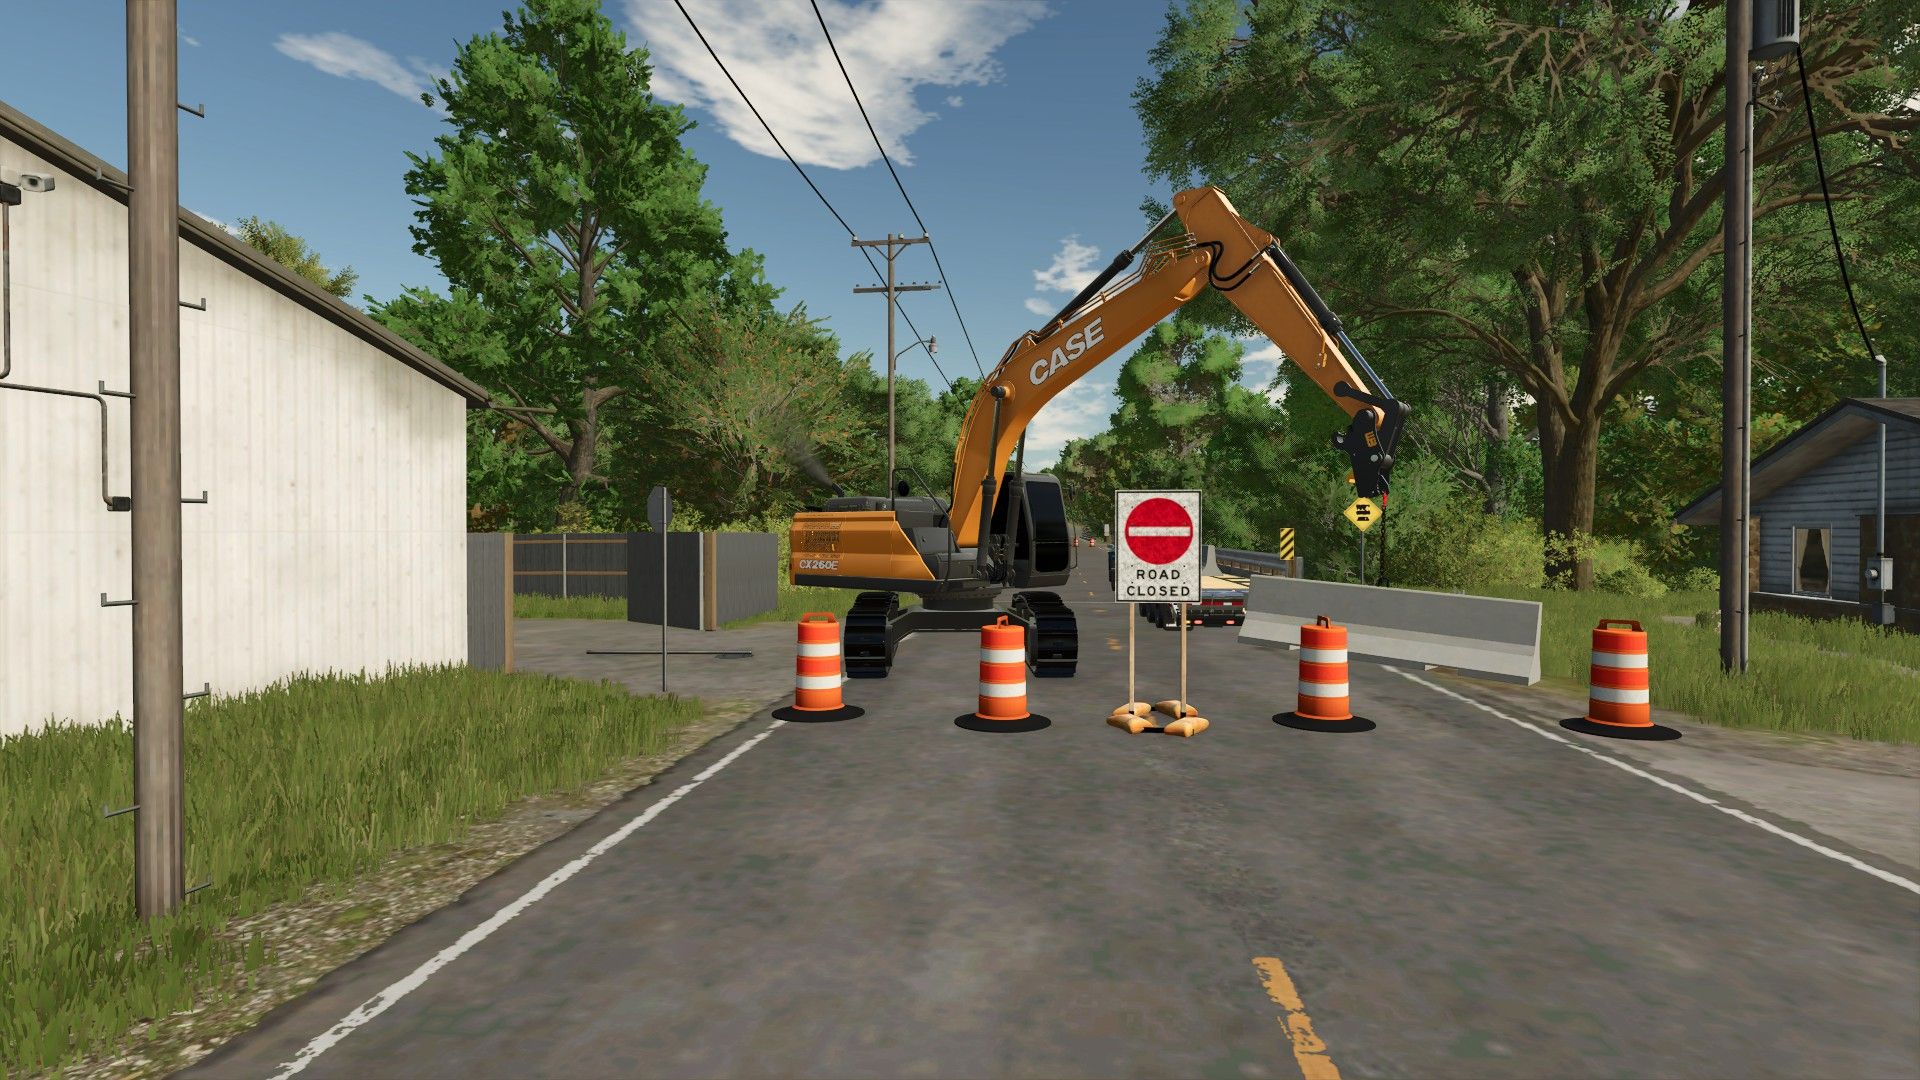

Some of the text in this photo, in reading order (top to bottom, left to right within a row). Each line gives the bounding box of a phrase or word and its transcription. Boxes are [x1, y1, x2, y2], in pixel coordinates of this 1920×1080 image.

[1029, 316, 1105, 385] CASE
[799, 559, 839, 570] CX260E
[1136, 569, 1181, 580] ROAD
[1126, 585, 1190, 597] CLOSED
